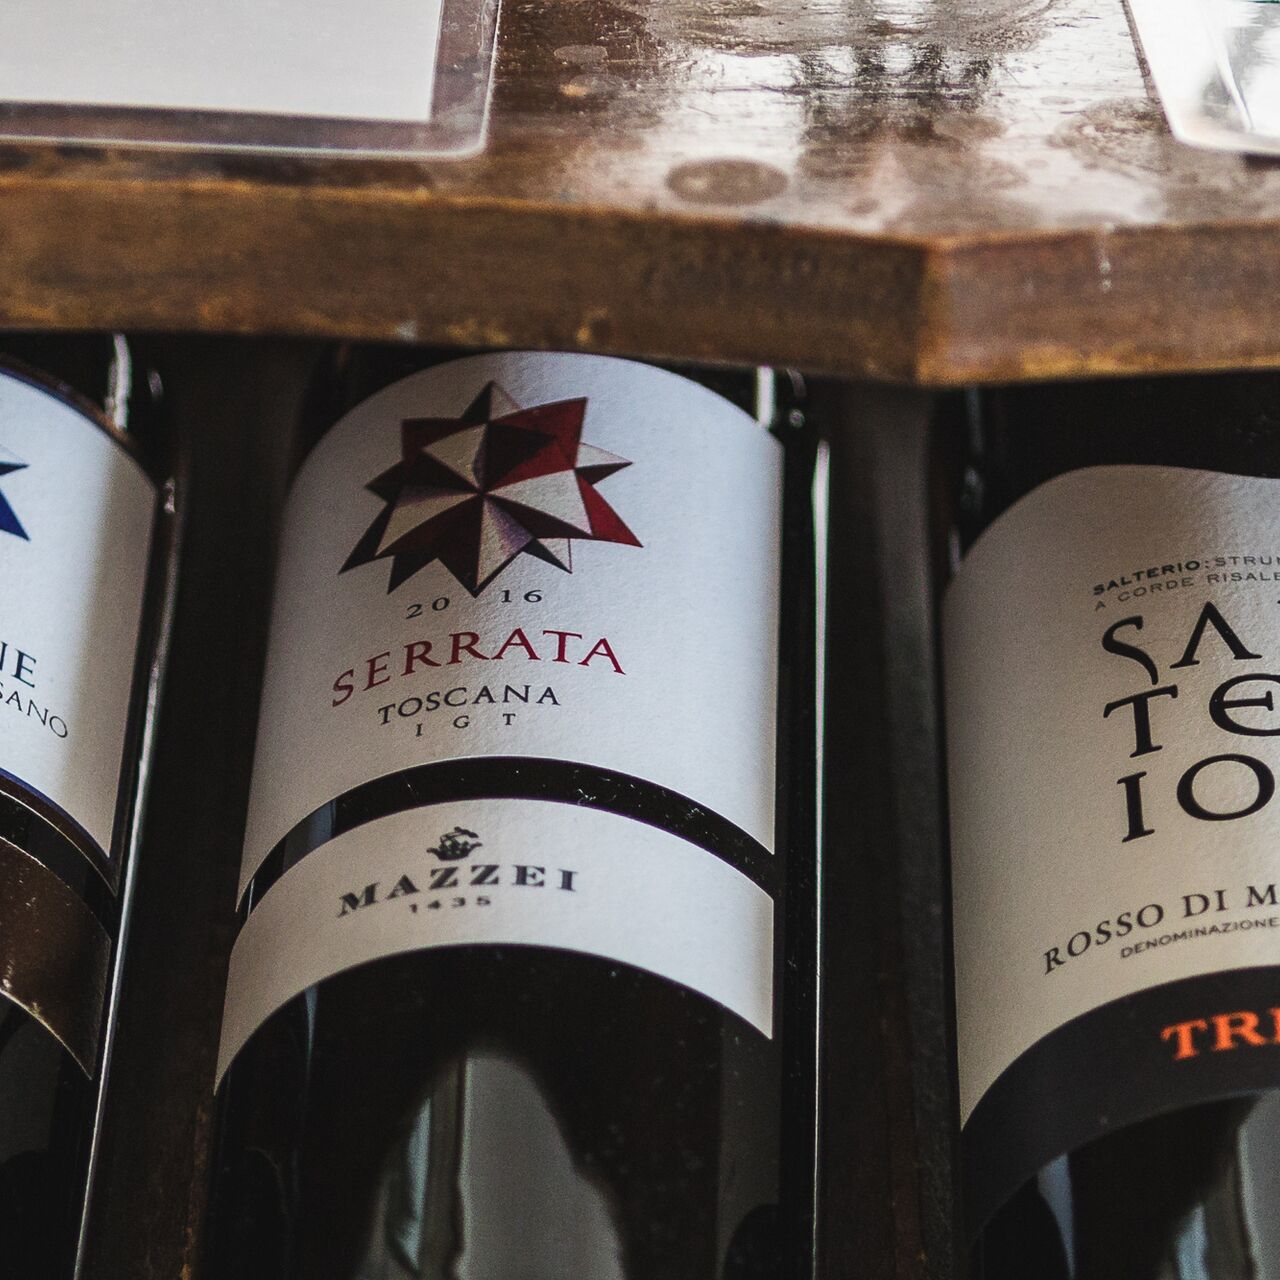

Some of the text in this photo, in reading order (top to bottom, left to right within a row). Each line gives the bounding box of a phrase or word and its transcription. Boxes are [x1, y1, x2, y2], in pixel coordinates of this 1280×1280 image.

[1095, 601, 1107, 612] A
[1117, 577, 1194, 602] CORDE
[332, 627, 626, 707] SERRATA
[376, 684, 561, 726] TOSCANA
[1115, 753, 1276, 844] IO
[336, 864, 579, 917] MAZZEI
[409, 895, 491, 913] 1435
[1043, 903, 1164, 976] ROSSO
[1182, 889, 1229, 919] DI
